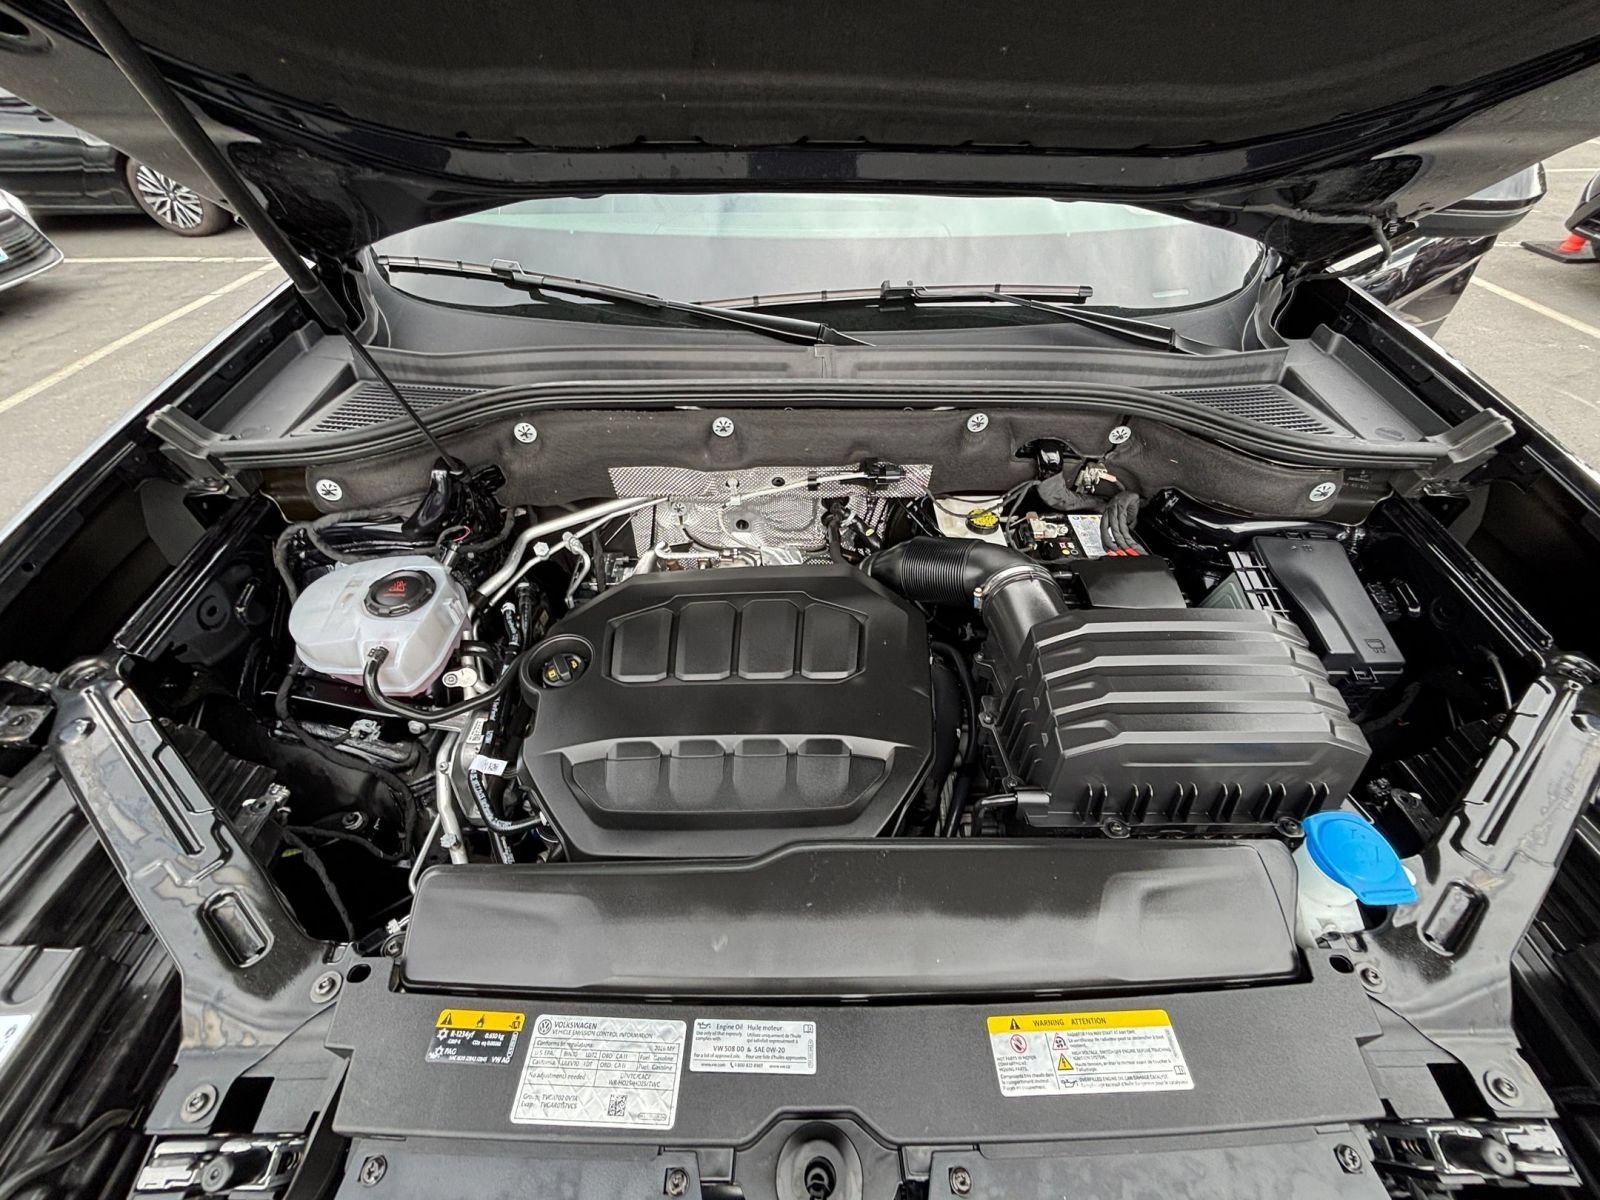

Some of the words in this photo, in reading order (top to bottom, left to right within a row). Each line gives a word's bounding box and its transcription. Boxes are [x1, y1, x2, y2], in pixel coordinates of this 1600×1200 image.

[554, 1020, 598, 1029] VOLKSWAGEN
[1033, 1019, 1065, 1027] WARNING
[1071, 1017, 1107, 1025] ATTENTION
[444, 1047, 458, 1055] PAG
